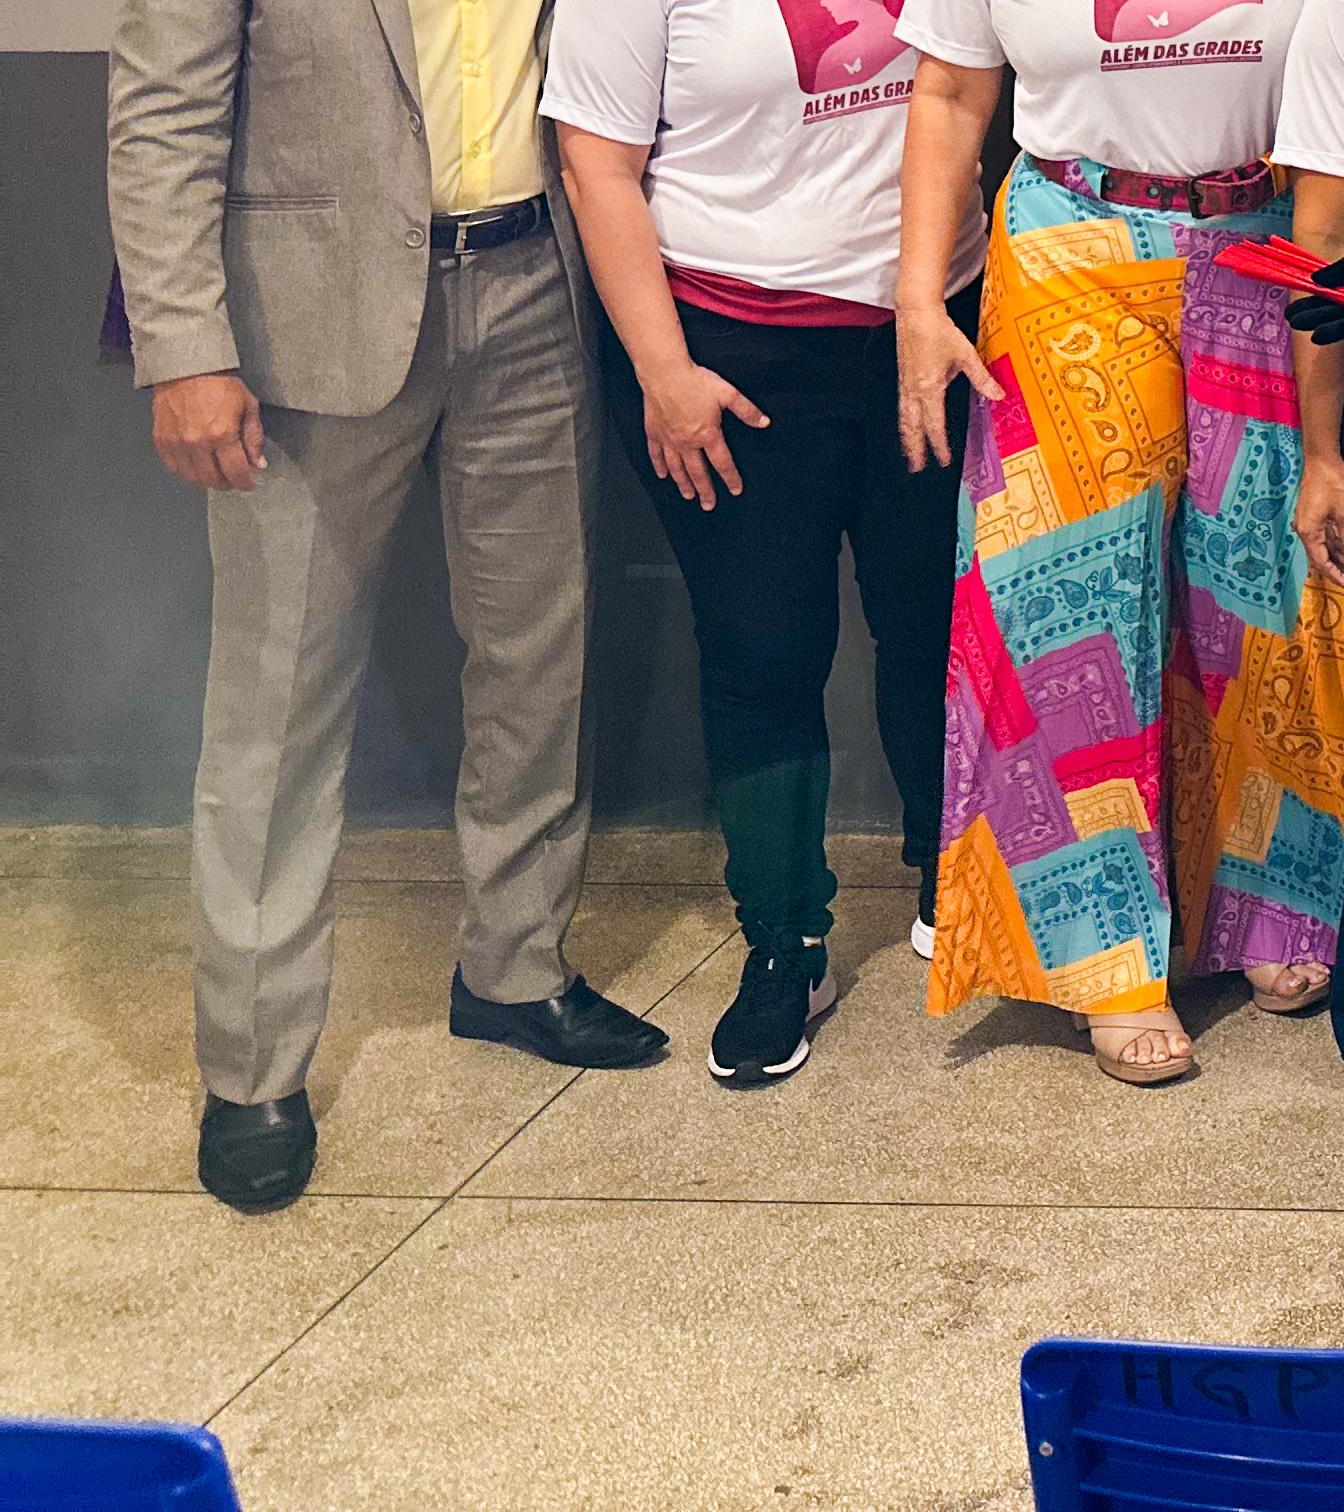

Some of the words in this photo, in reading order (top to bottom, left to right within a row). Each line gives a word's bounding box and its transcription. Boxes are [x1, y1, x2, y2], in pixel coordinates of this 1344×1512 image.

[1101, 45, 1149, 64] ALÉM
[1153, 43, 1189, 60] DAS
[1193, 40, 1263, 56] GRADES
[803, 94, 845, 117] ALÉM
[850, 86, 880, 106] DAS
[884, 79, 914, 98] GRA
[1121, 1353, 1327, 1420] HGP
